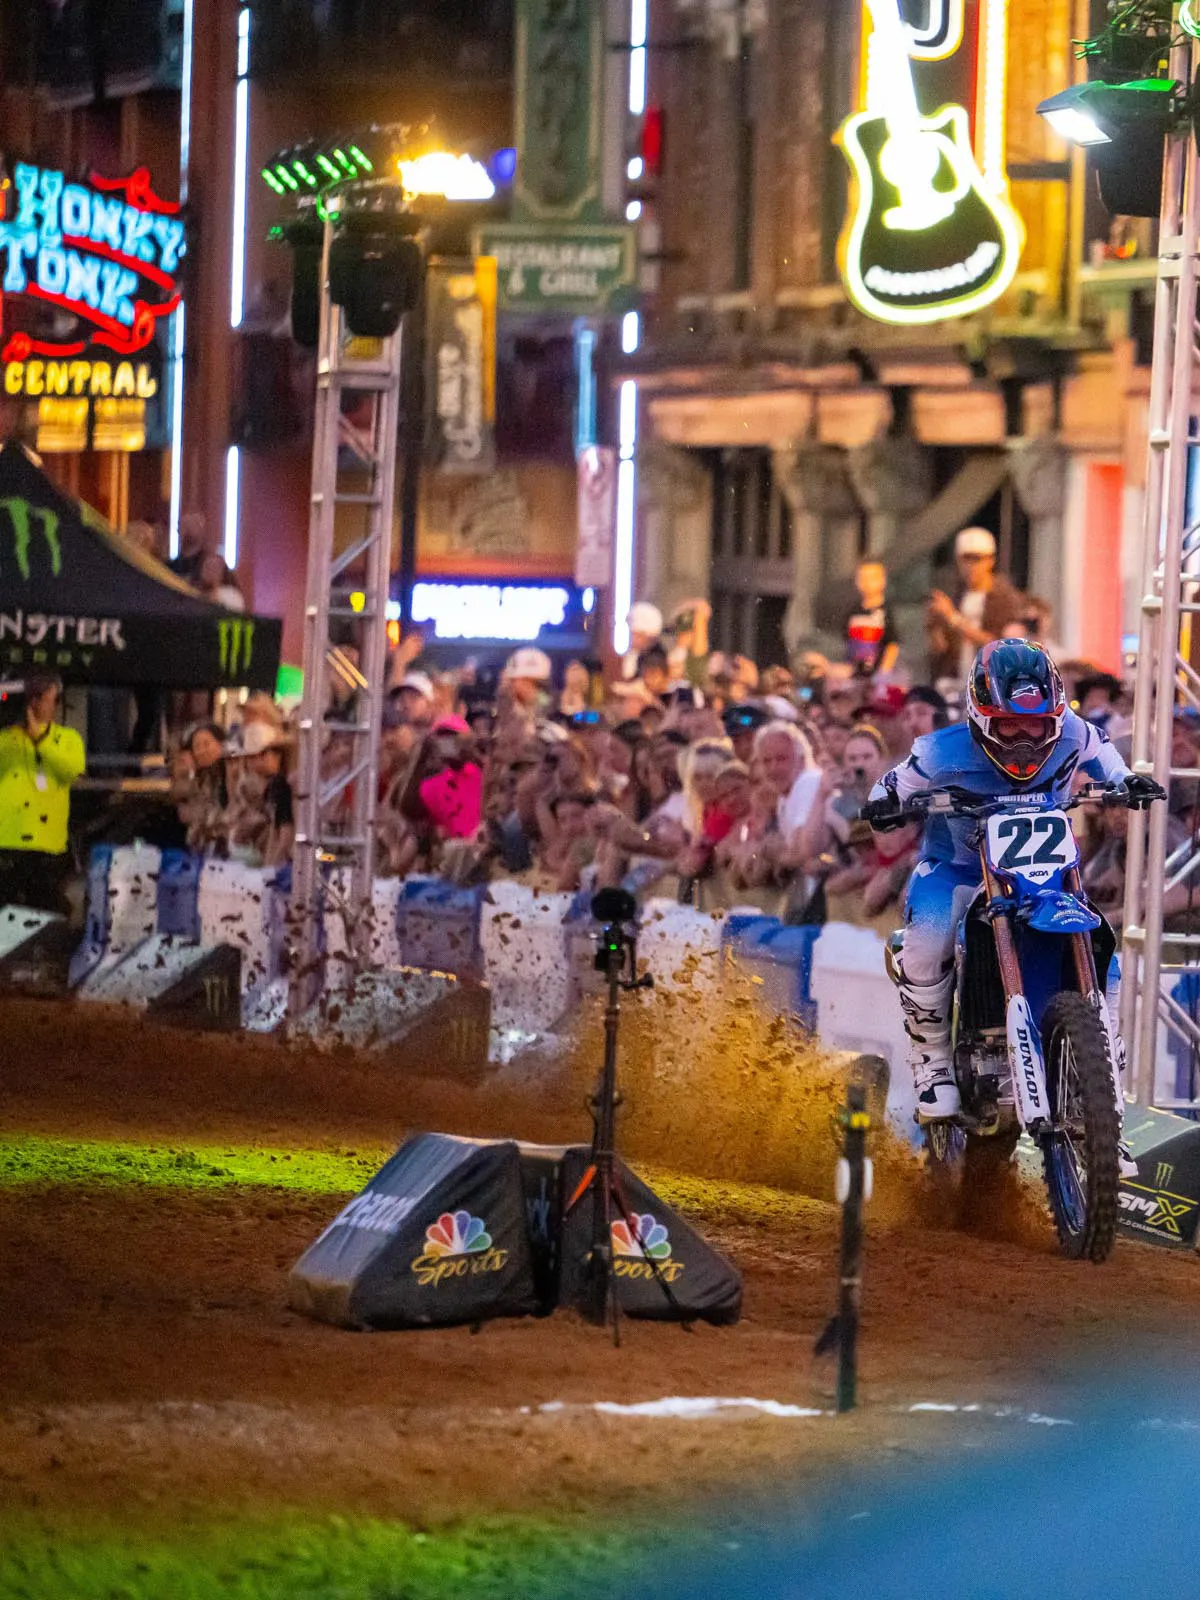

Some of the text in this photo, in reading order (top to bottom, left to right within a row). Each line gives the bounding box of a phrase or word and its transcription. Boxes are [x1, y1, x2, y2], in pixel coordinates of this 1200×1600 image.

[14, 162, 186, 273] HONKY
[0, 221, 138, 326] TONK
[4, 361, 157, 398] CENTRAL
[997, 816, 1066, 869] 22
[1016, 1027, 1041, 1109] DUNLOP
[1117, 1191, 1192, 1234] SMX
[410, 1248, 509, 1287] Sports
